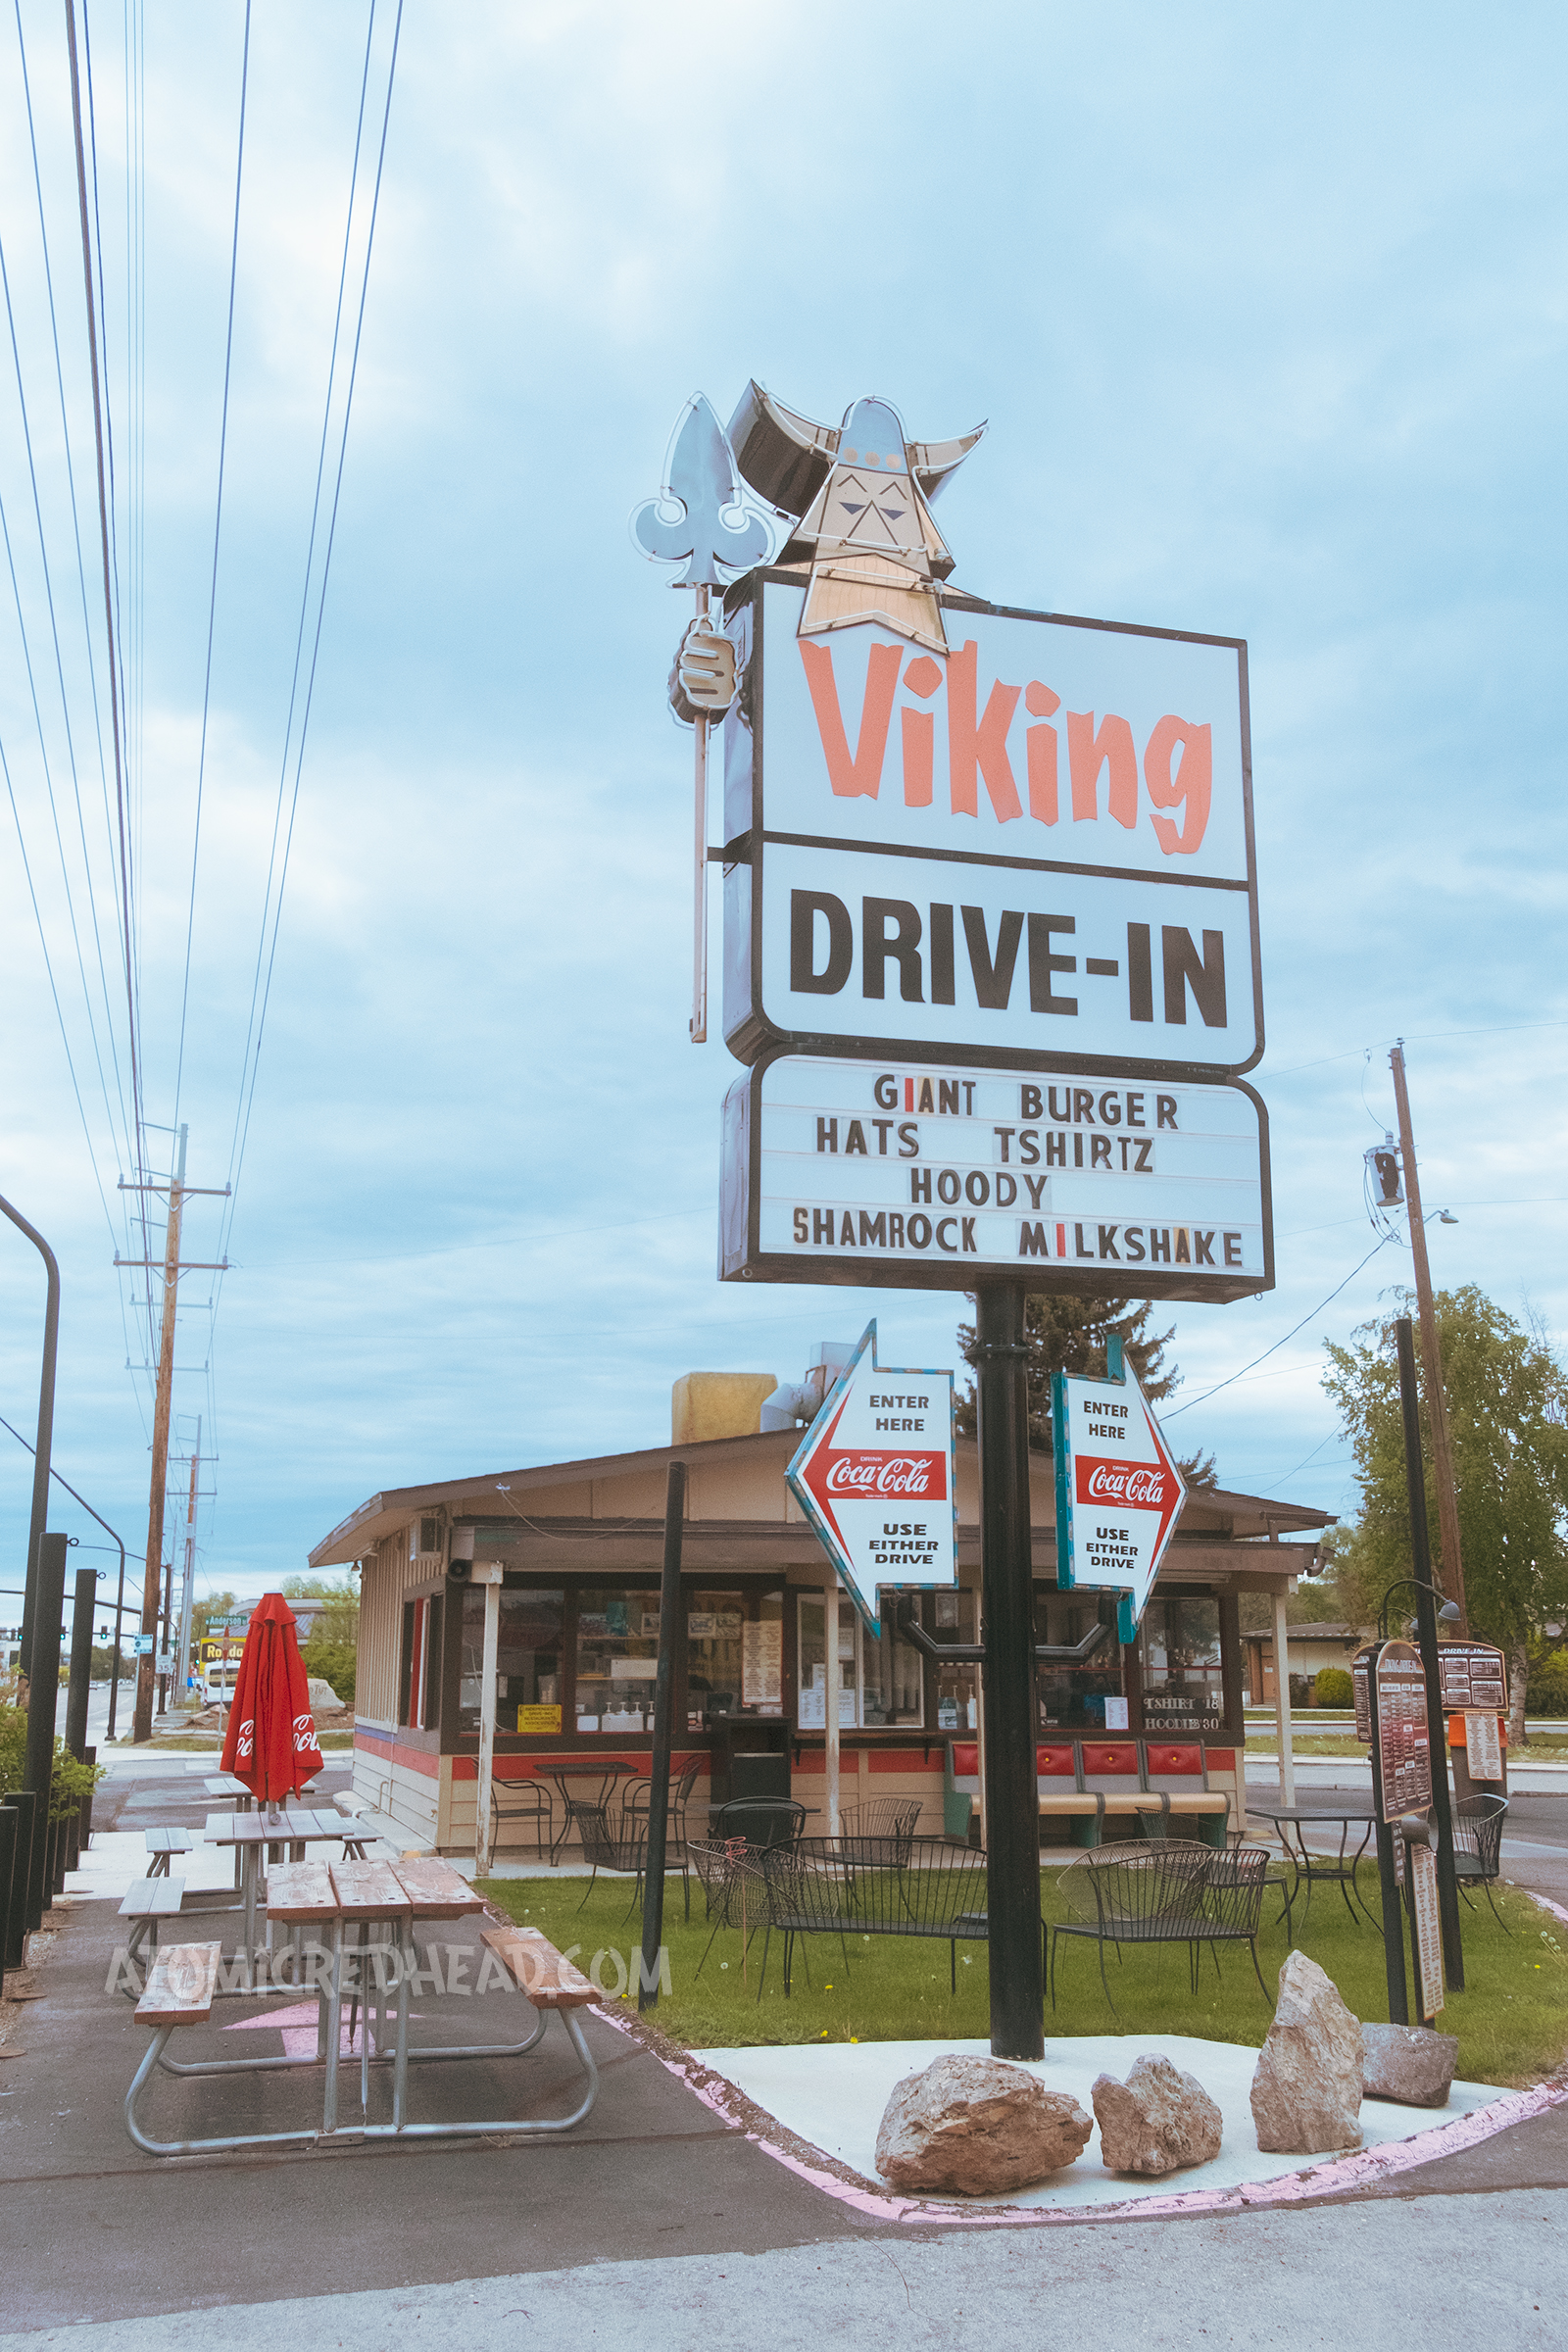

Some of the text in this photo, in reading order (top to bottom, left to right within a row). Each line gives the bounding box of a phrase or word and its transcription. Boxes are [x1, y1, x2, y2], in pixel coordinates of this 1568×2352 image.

[798, 639, 1212, 856] Viking
[790, 888, 1227, 1028] DRIVE-IN
[873, 1074, 1178, 1130] GIANT BURGER
[816, 1116, 1154, 1172] HATS TSHIRTZ
[910, 1168, 1048, 1210] HOODY
[793, 1207, 1243, 1267] SHAMROCK MILKSHAKE
[869, 1395, 929, 1409] ENTER
[1083, 1400, 1129, 1419] ENTER
[875, 1418, 924, 1432] HERE
[1088, 1424, 1126, 1440] HERE
[826, 1457, 933, 1493] Coca-Cola
[1088, 1465, 1165, 1503] Coca-Cola
[882, 1523, 927, 1537] USE
[1096, 1527, 1129, 1542] USE
[868, 1540, 939, 1551] EITHER
[1086, 1543, 1139, 1557] EITHER
[874, 1553, 934, 1565] DRIVE
[1090, 1555, 1135, 1570] DRIVE
[210, 1616, 241, 1626] Anderson
[207, 1645, 244, 1658] Rodo
